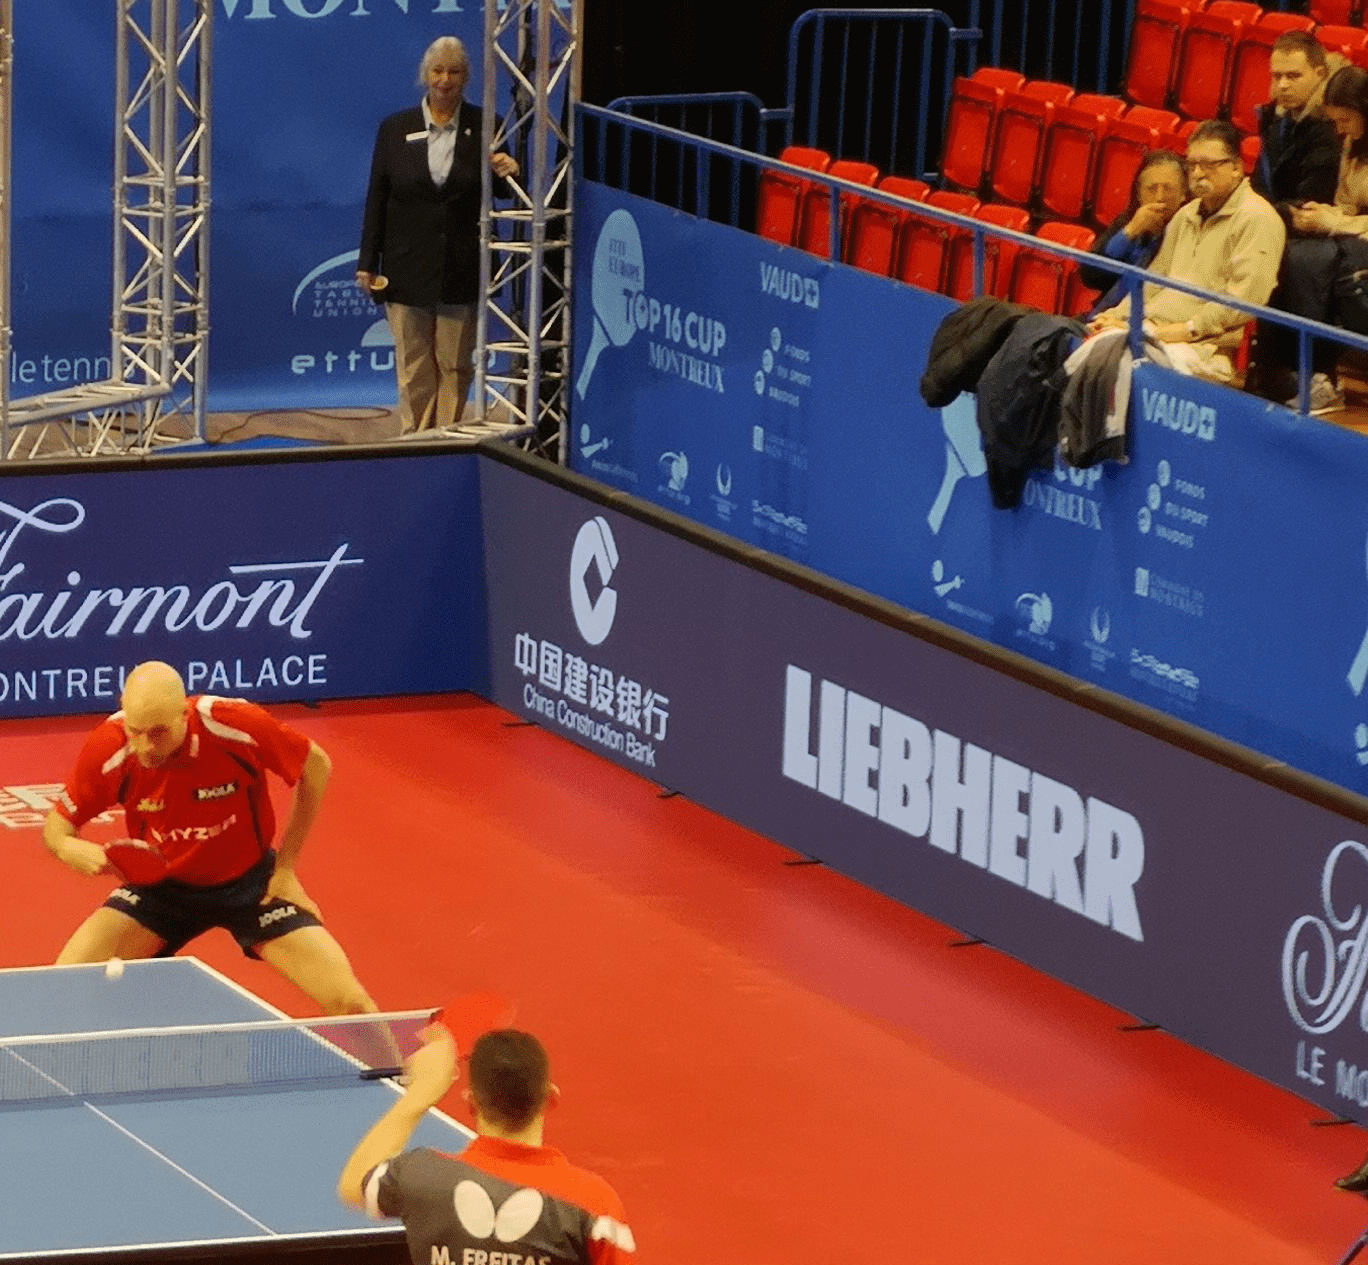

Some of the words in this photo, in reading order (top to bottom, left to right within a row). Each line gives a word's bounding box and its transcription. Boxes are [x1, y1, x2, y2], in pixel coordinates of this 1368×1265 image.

[760, 261, 803, 303] VAUD
[623, 288, 661, 334] TOP
[664, 304, 681, 343] 16
[685, 312, 726, 357] CUP
[648, 341, 725, 393] MONTREUX
[1143, 387, 1200, 434] VAUD
[1023, 477, 1102, 531] ONTREUX
[187, 655, 327, 691] PALACE
[515, 632, 669, 741] 中国建设银行
[524, 683, 555, 720] China
[557, 699, 624, 752] Construction
[626, 732, 656, 767] Bank
[782, 664, 1144, 942] LIEBHERR
[1296, 1040, 1326, 1086] LE
